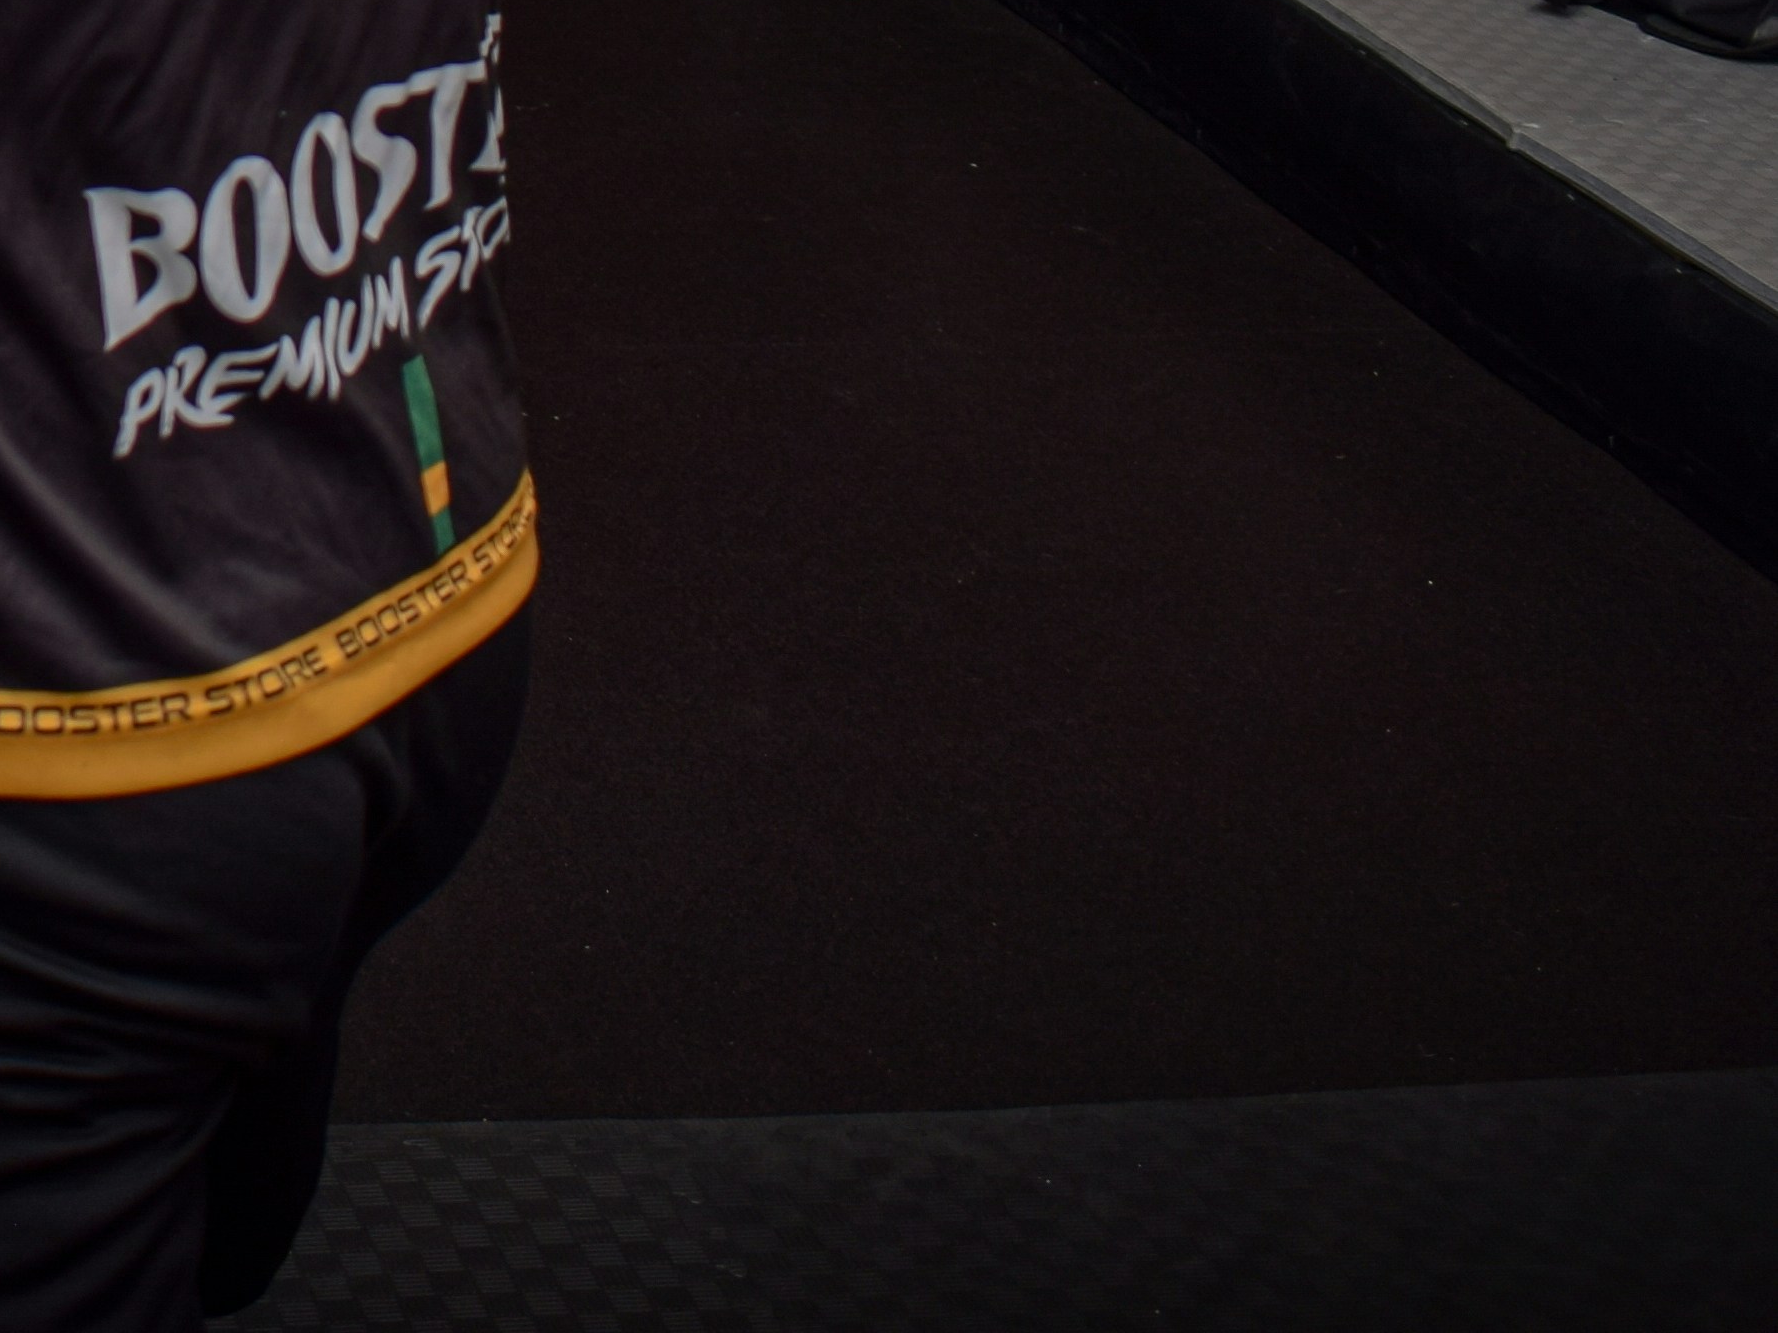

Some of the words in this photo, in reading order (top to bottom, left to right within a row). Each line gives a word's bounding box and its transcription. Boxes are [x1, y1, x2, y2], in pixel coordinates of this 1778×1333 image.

[112, 255, 411, 459] PREMIUM
[415, 195, 510, 332] STO
[201, 646, 330, 717] STORE
[335, 559, 473, 660] BOOSTER
